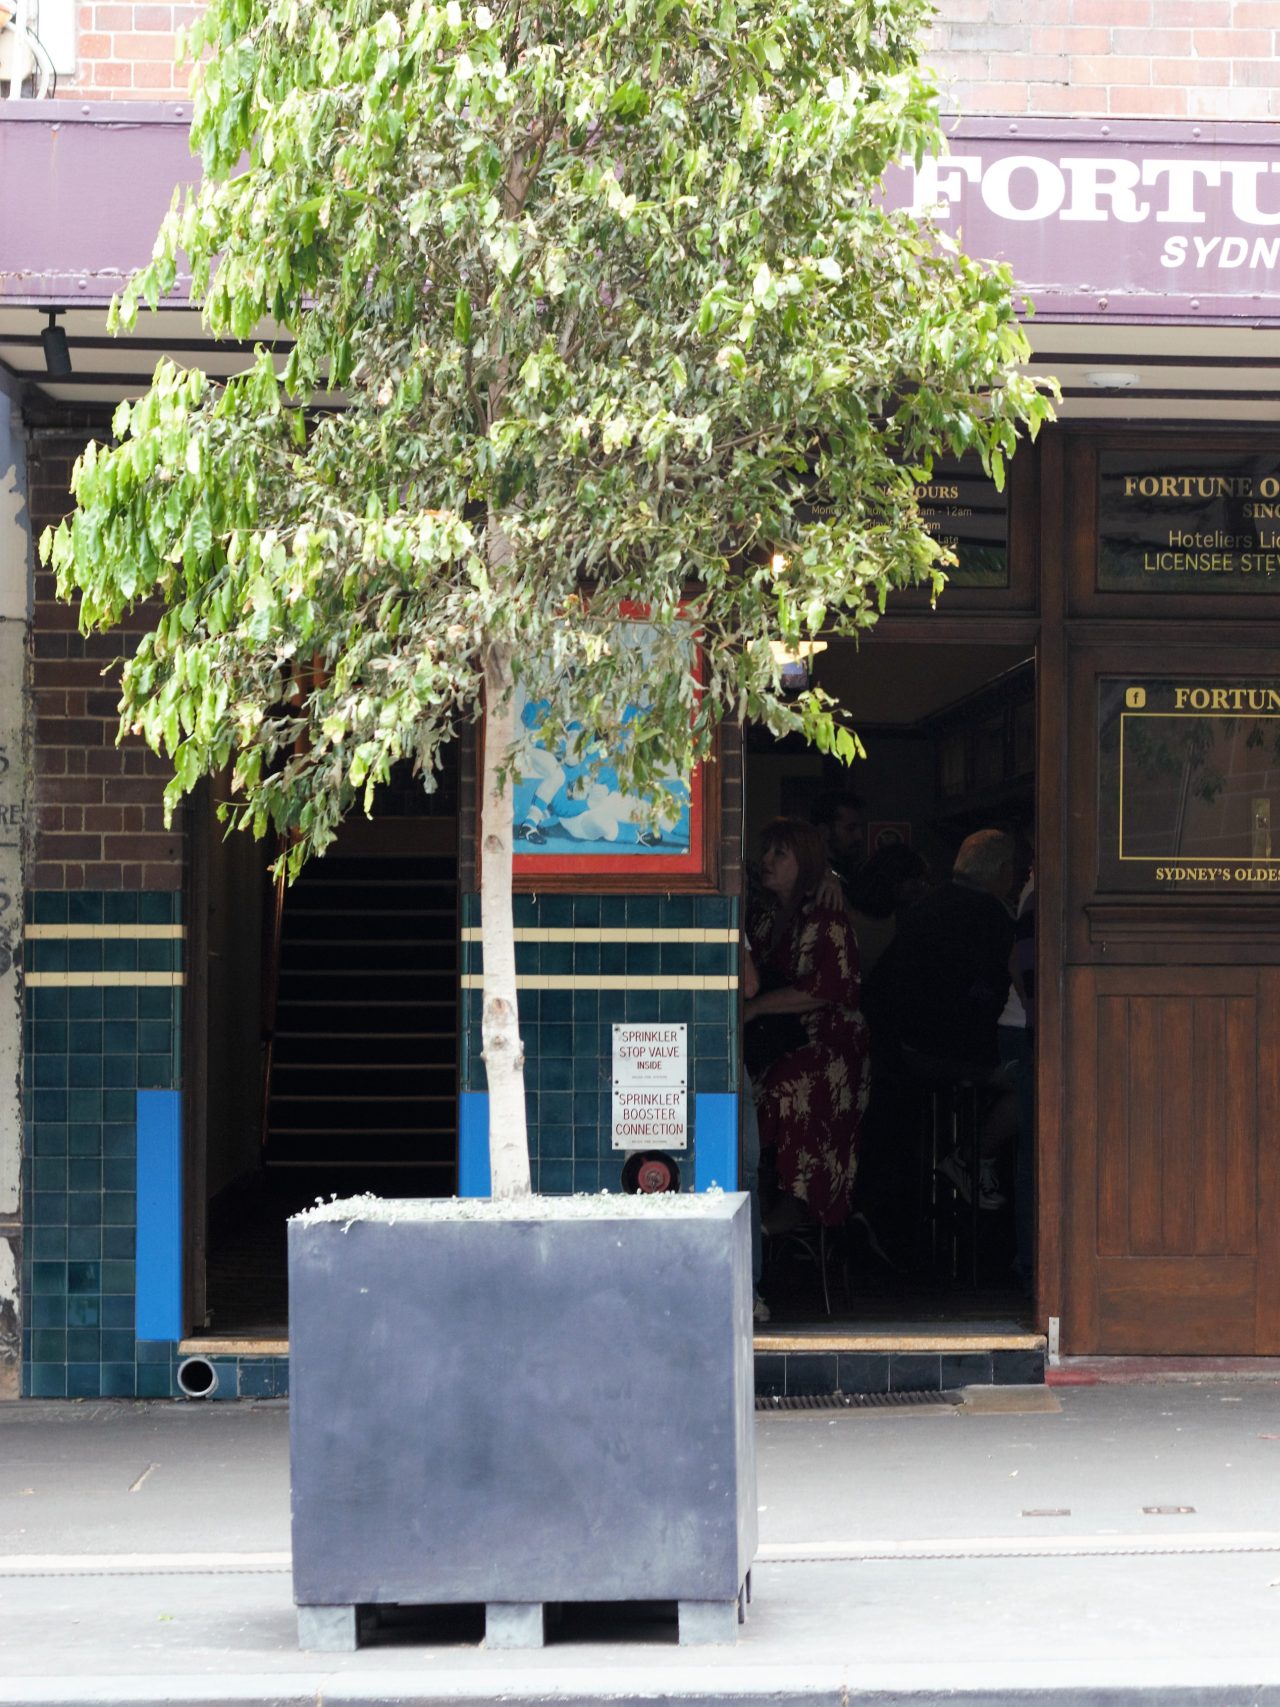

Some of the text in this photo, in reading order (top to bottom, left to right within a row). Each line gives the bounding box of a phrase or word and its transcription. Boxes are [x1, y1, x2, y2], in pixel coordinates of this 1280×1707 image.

[1123, 476, 1253, 497] FORTUNE
[946, 506, 972, 516] 12am
[1168, 530, 1253, 548] Hoteliers
[1144, 553, 1233, 570] LICENSEE
[1156, 868, 1231, 880] SYDNEY'S
[622, 1031, 677, 1042] SPRINKLER
[620, 1047, 680, 1057] STOP VALVE
[637, 1061, 662, 1070] INSIDE
[619, 1094, 680, 1105] SPRINKLER
[623, 1109, 676, 1120] BOOSTER
[616, 1124, 683, 1136] CONNECTION
